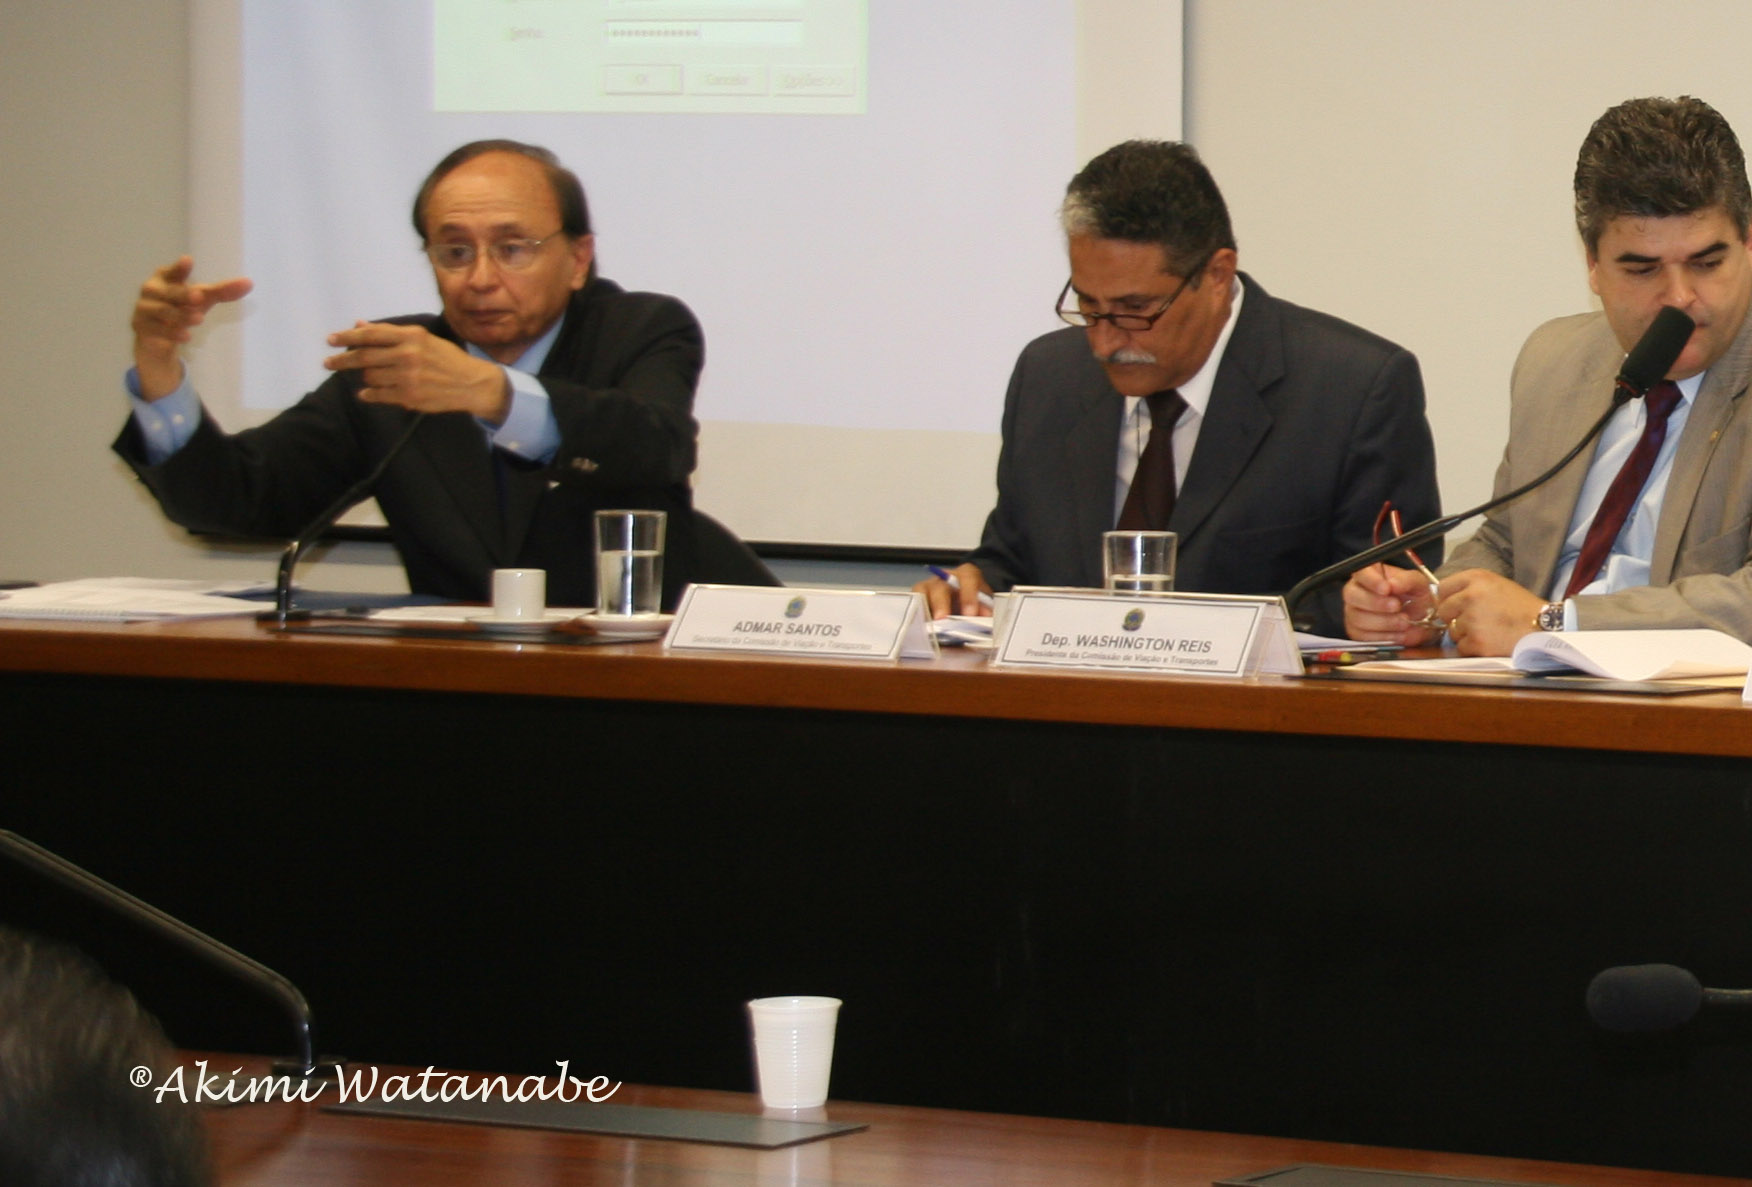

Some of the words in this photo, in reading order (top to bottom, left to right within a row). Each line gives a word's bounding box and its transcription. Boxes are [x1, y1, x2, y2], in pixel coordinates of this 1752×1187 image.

[733, 621, 783, 634] ADMAR
[786, 622, 842, 637] SANTOS
[1041, 632, 1071, 647] Dep.
[1076, 634, 1176, 651] WASHINGTON
[1178, 640, 1212, 653] REIS
[1025, 648, 1067, 658] Presidente
[1082, 651, 1121, 660] Comissão
[1123, 653, 1133, 661] de
[1135, 653, 1160, 663] Viação
[1172, 655, 1218, 666] Transportes
